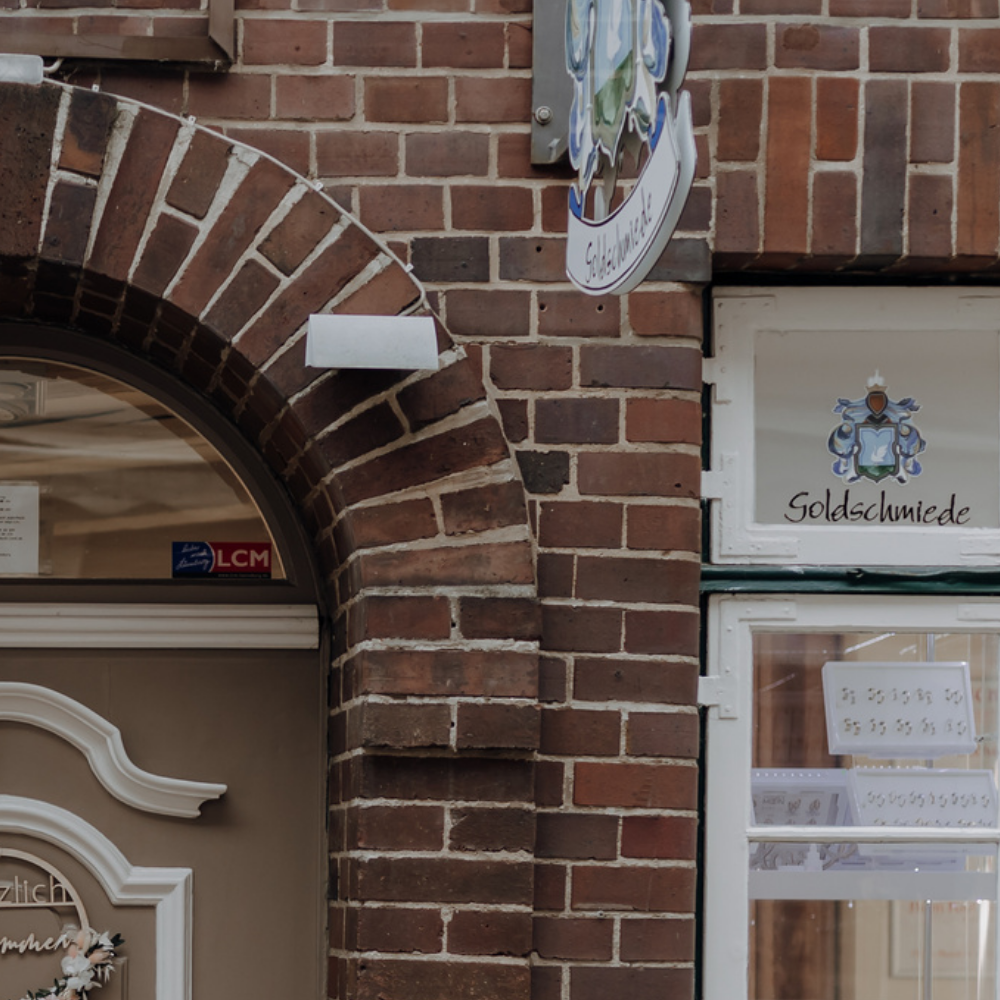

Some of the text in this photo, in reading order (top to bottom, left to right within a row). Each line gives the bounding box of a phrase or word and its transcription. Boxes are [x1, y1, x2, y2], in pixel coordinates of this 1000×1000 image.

[584, 186, 652, 284] Goldschmiede
[784, 488, 971, 526] Goldschmiede
[217, 550, 269, 567] LCM
